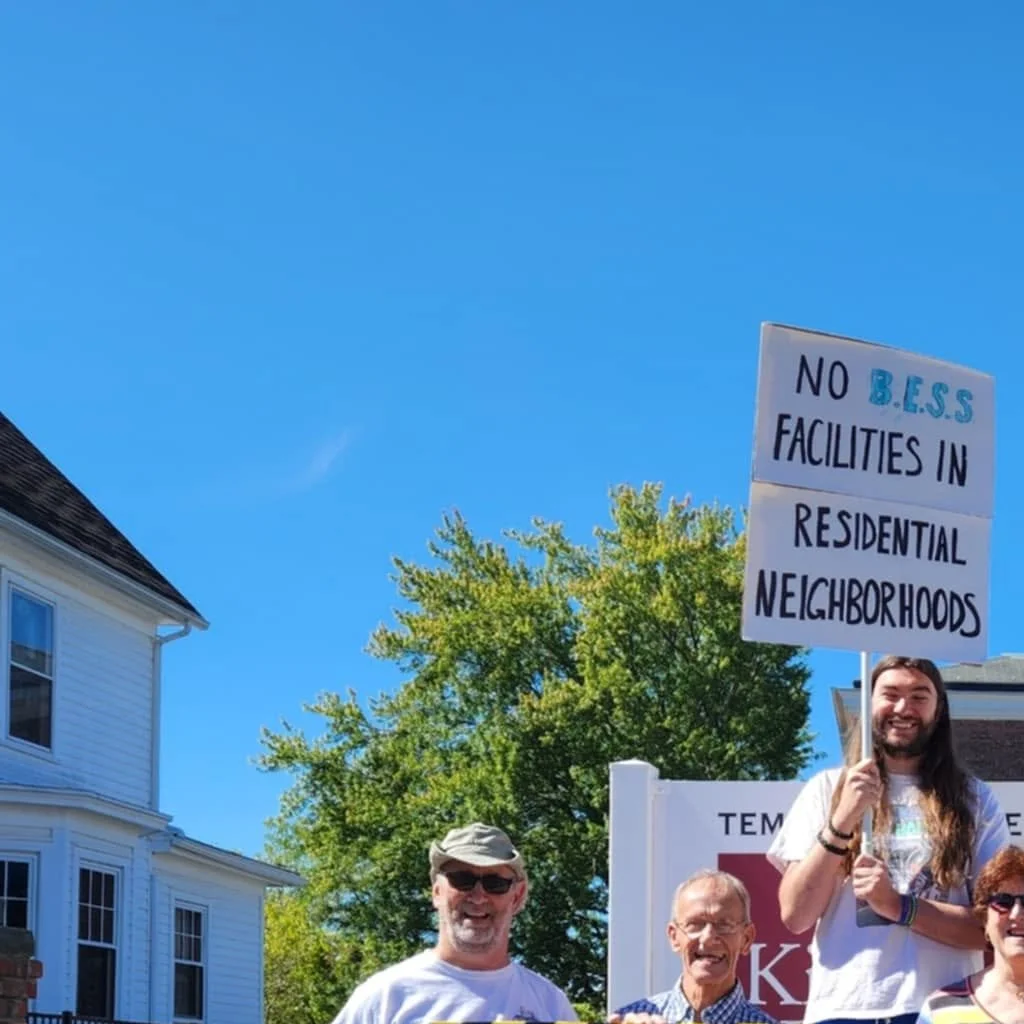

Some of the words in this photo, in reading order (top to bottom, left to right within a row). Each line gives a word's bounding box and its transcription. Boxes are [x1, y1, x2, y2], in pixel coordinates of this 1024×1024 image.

[796, 354, 849, 400] NO
[869, 368, 973, 423] B.E.S.S
[773, 413, 922, 476] FACILITIES
[937, 440, 967, 487] IN
[794, 503, 967, 565] RESIDENTIAL
[755, 569, 981, 638] NEIGHBORHOODS
